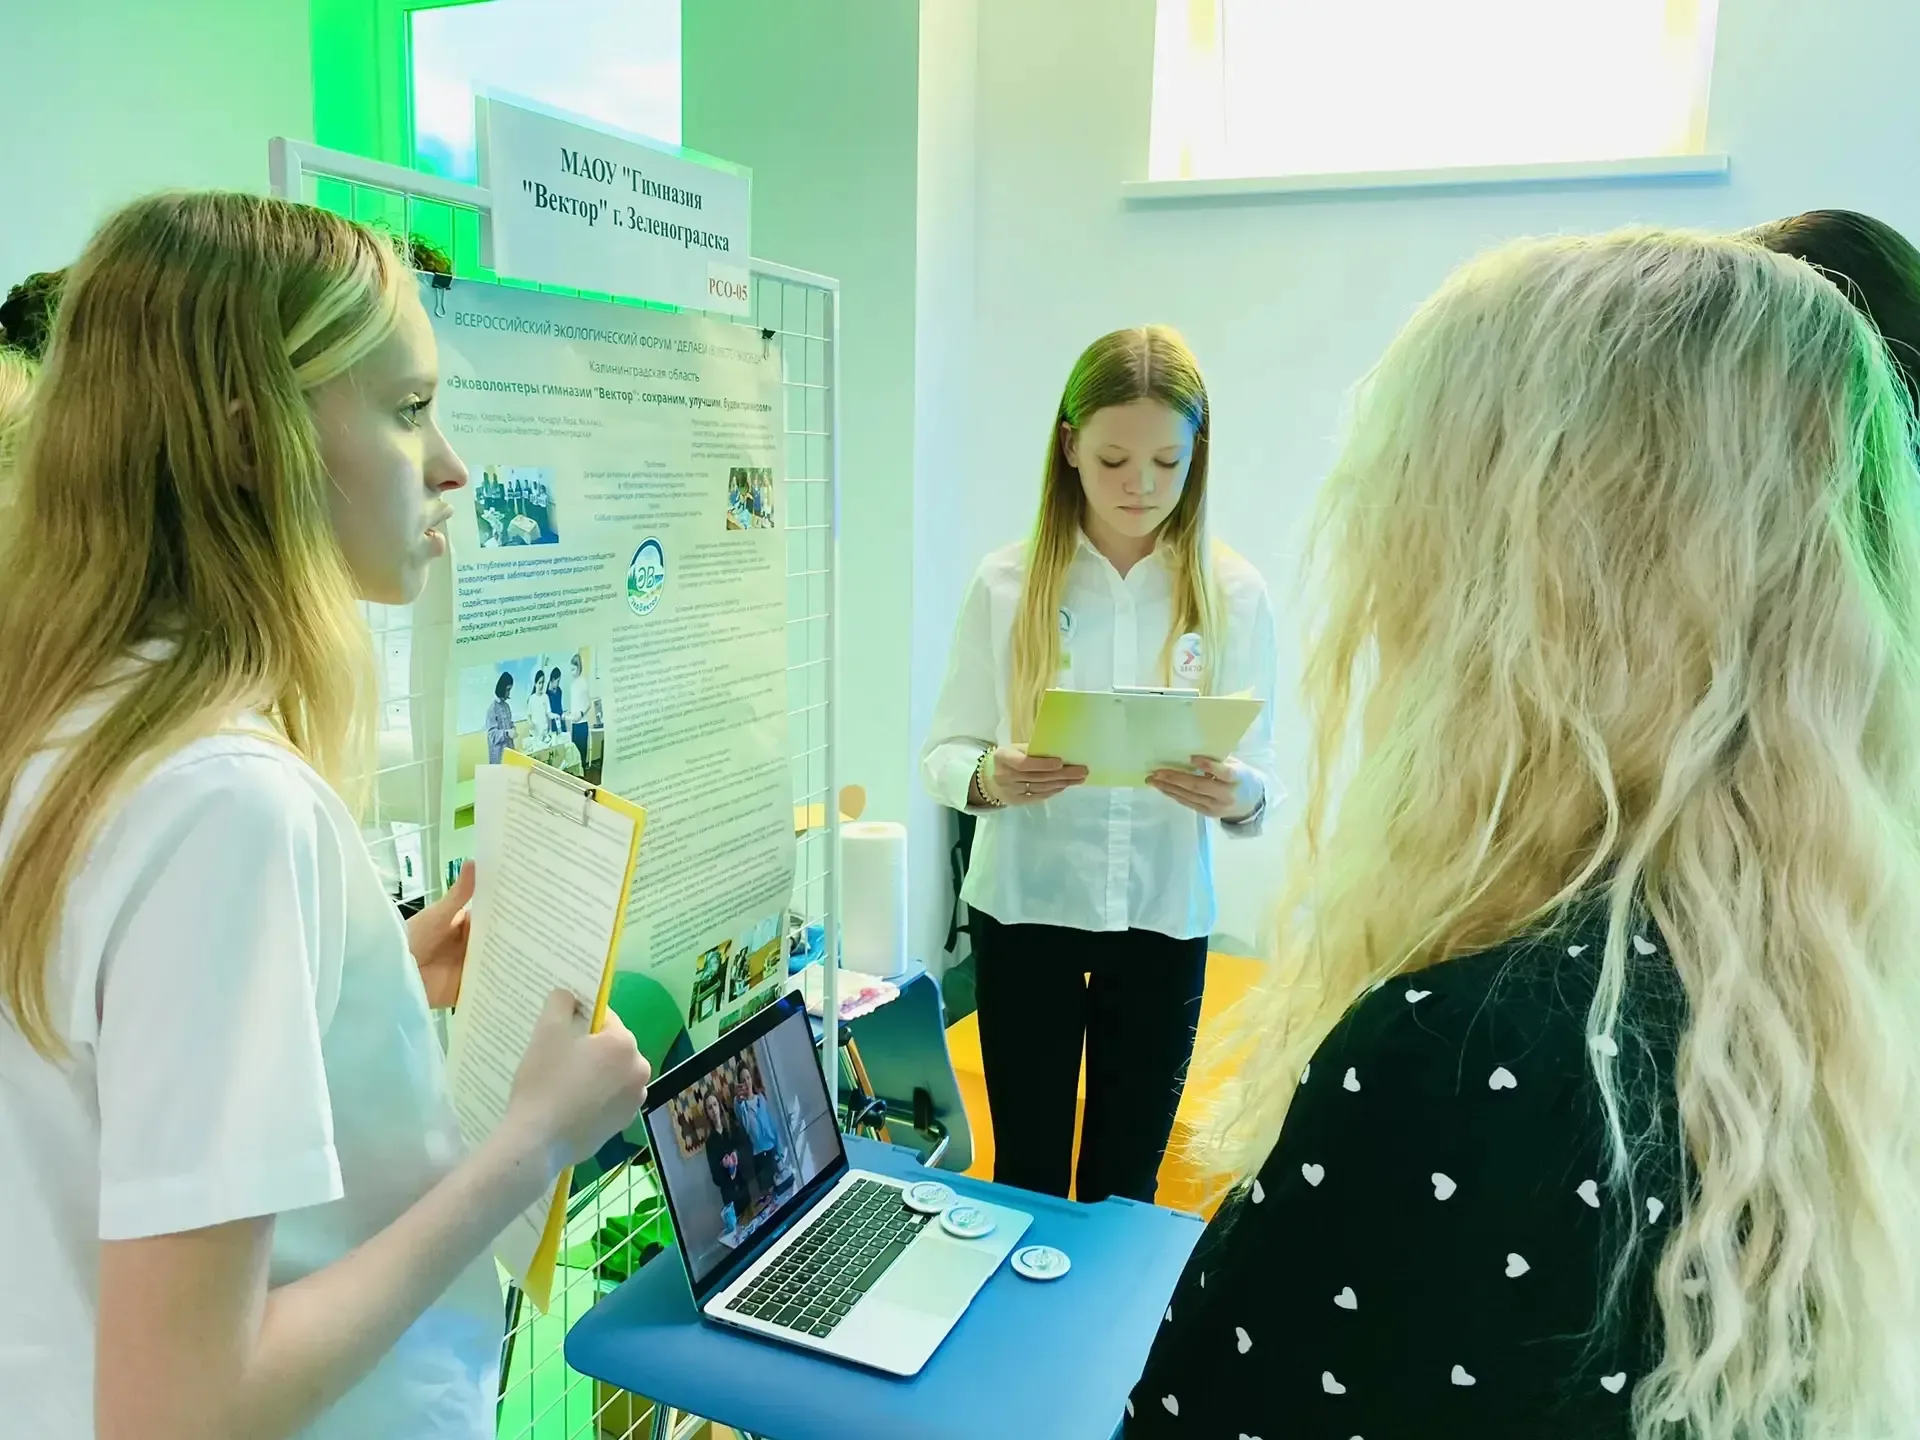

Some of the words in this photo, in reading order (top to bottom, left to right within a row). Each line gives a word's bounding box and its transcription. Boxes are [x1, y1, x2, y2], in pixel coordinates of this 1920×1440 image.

[560, 147, 618, 185] МАОУ
[622, 166, 702, 210] "Гимназия
[522, 179, 608, 227] "Вектор"
[613, 209, 623, 227] г.
[627, 206, 729, 253] Зеленоградска
[708, 277, 748, 302] РСО-05
[455, 311, 551, 335] ВСЕРОССИЙСКИЙ
[553, 324, 637, 346] ЭКОЛОГИЧЕСКИЙ
[639, 336, 672, 350] ФОРУМ
[589, 360, 666, 379] Калининградская
[669, 369, 700, 382] область
[447, 375, 540, 396] «Эковолонтеры
[542, 384, 592, 398] гимназии
[642, 392, 687, 407] сохраним,
